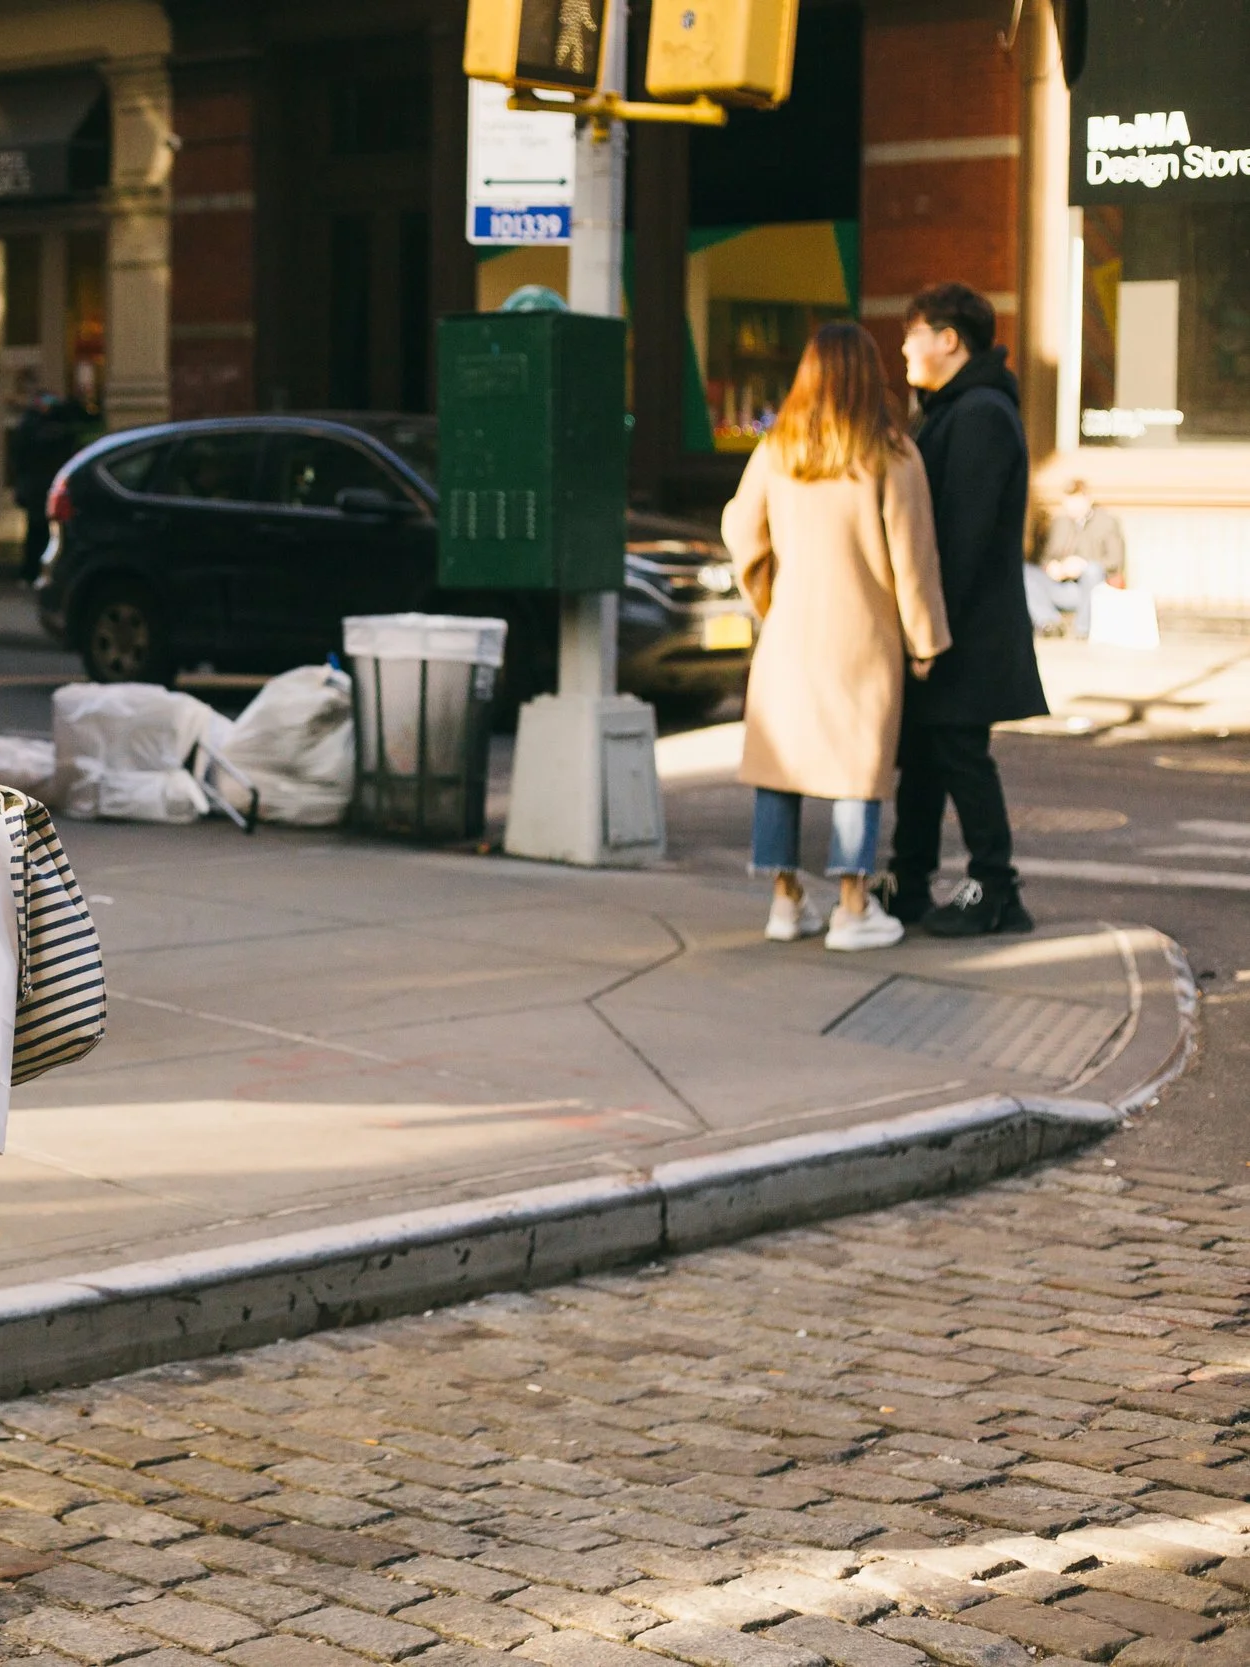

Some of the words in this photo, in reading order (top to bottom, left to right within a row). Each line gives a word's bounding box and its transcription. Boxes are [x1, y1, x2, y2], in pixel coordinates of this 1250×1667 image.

[1087, 111, 1191, 151] MoMA
[1086, 149, 1179, 188] Design
[1183, 145, 1250, 179] Store
